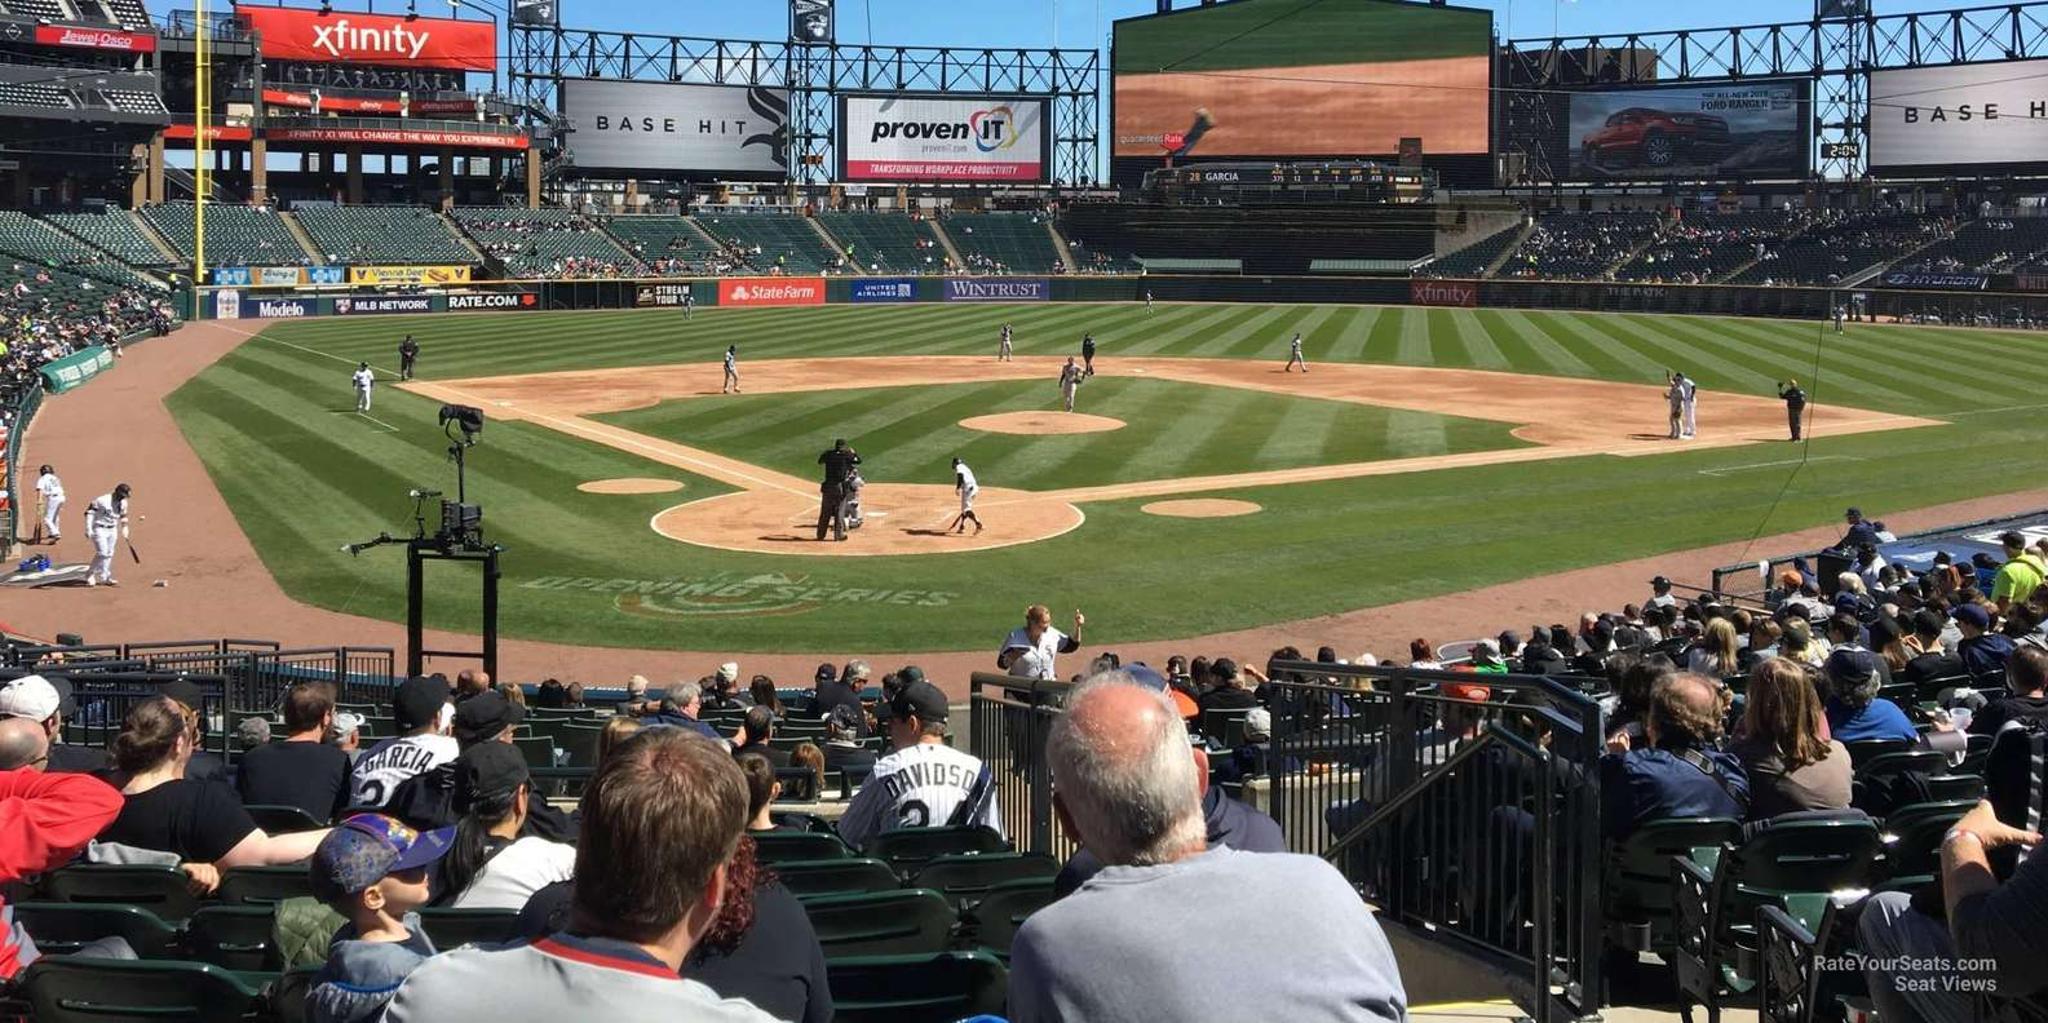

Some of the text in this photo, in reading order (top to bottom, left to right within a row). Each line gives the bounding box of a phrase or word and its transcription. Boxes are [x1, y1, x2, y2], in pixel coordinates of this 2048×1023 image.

[60, 30, 132, 47] Jewel-Osco
[312, 19, 430, 59] xfinity
[1904, 103, 1999, 124] BASE
[596, 115, 746, 135] BASE HIT
[871, 120, 1005, 143] proven IT
[288, 130, 322, 139] XFINITY
[338, 131, 360, 139] WILL
[362, 131, 400, 141] CHANGE
[403, 133, 419, 142] THE
[422, 134, 440, 143] WAY
[442, 135, 460, 144] YOU
[1164, 133, 1183, 143] Rate
[1830, 144, 1858, 157] 2:04
[870, 163, 1018, 176] TRANSFORMING WORKPLACE PRODUCTIVITY
[1205, 172, 1239, 181] GARCIA
[655, 285, 690, 294] STREAM
[952, 281, 1041, 297] WINTRUST
[1415, 283, 1472, 304] xfinity
[355, 300, 429, 311] MLB NETWORK
[449, 294, 518, 309] RATE.COM
[655, 295, 678, 304] YOUR
[260, 302, 304, 317] Modelo
[366, 746, 435, 773] GARCIA
[885, 762, 975, 800] DAVIDSO
